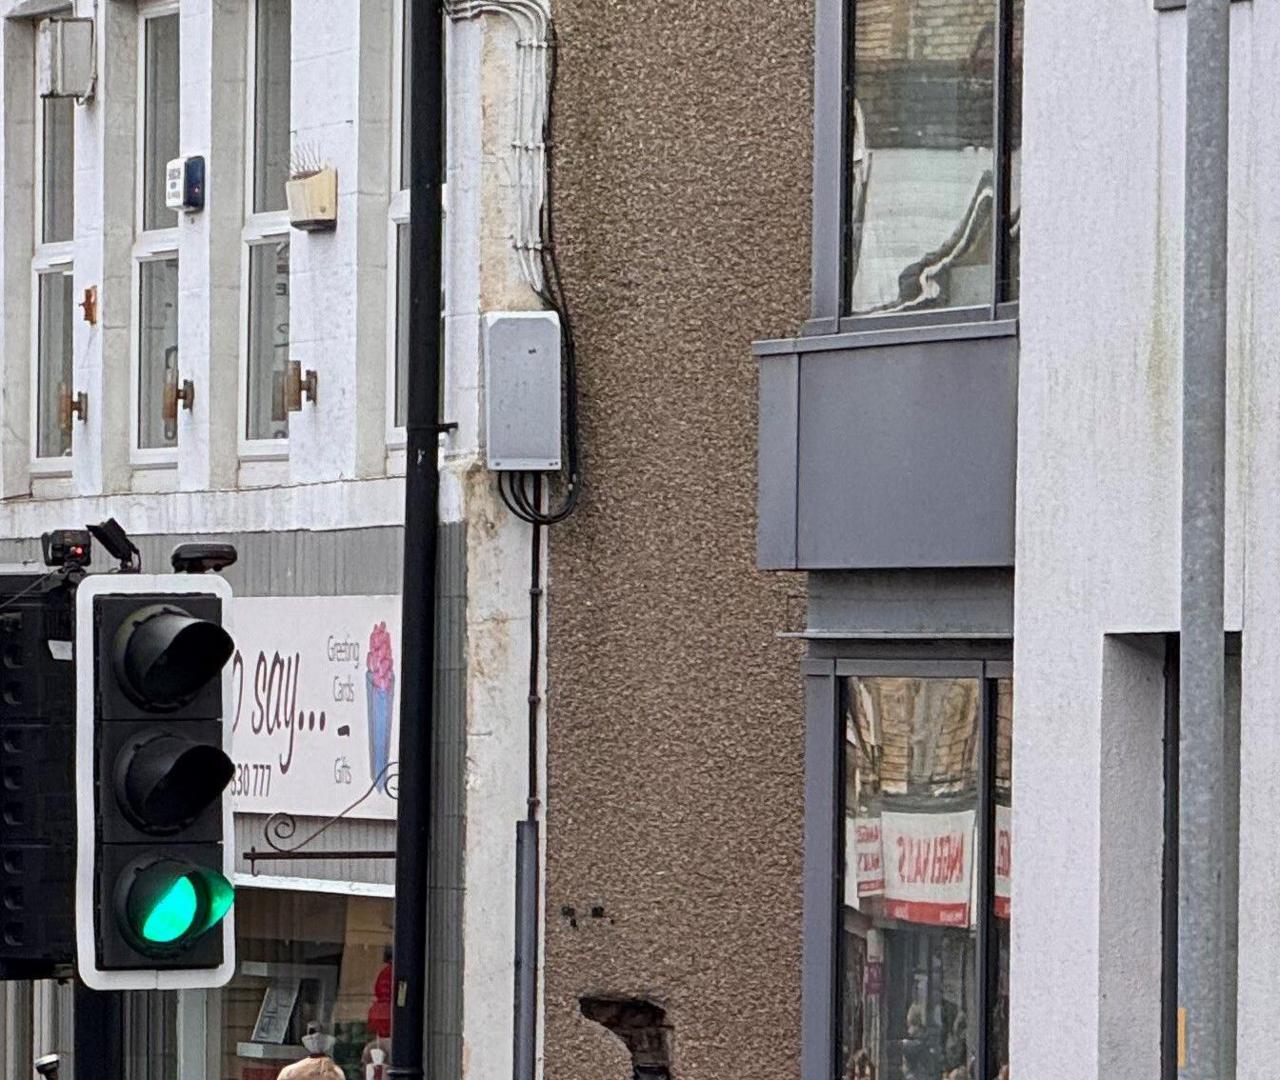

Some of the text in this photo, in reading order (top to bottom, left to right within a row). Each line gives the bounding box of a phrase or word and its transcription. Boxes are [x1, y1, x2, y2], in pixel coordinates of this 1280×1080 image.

[327, 635, 360, 669] Greeting
[333, 674, 355, 702] Cards
[252, 763, 272, 798] 777
[334, 756, 352, 784] Gifts
